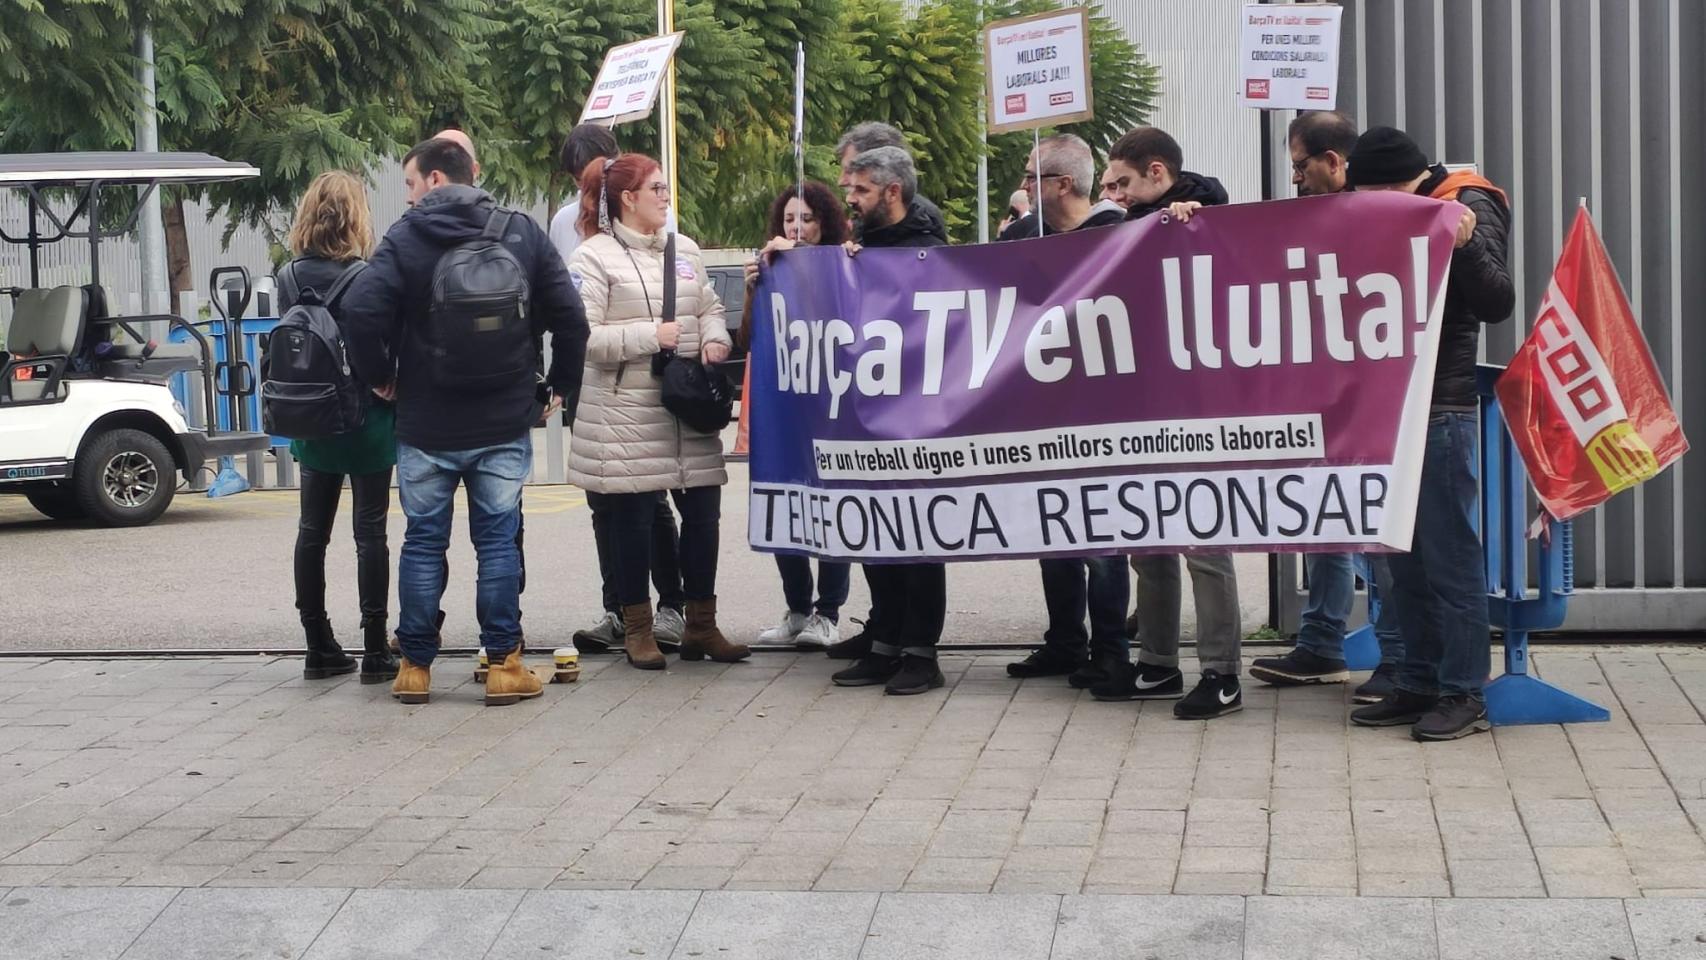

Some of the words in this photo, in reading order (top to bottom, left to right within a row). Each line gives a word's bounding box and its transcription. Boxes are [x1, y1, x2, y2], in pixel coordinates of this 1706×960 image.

[1017, 45, 1057, 64] MILLORES
[1261, 34, 1273, 45] PER
[1006, 69, 1047, 89] LABORALS
[1024, 295, 1136, 383] en
[1162, 236, 1429, 371] lluita!
[815, 446, 832, 470] Per
[836, 453, 853, 470] un
[854, 446, 909, 471] treball
[912, 446, 965, 475] digne
[969, 442, 978, 466] i
[983, 443, 1032, 465] unes
[1038, 434, 1113, 461] millors
[1119, 427, 1214, 454] condicions
[1220, 421, 1316, 450] laborals!
[752, 487, 1010, 551] TELEFONICA
